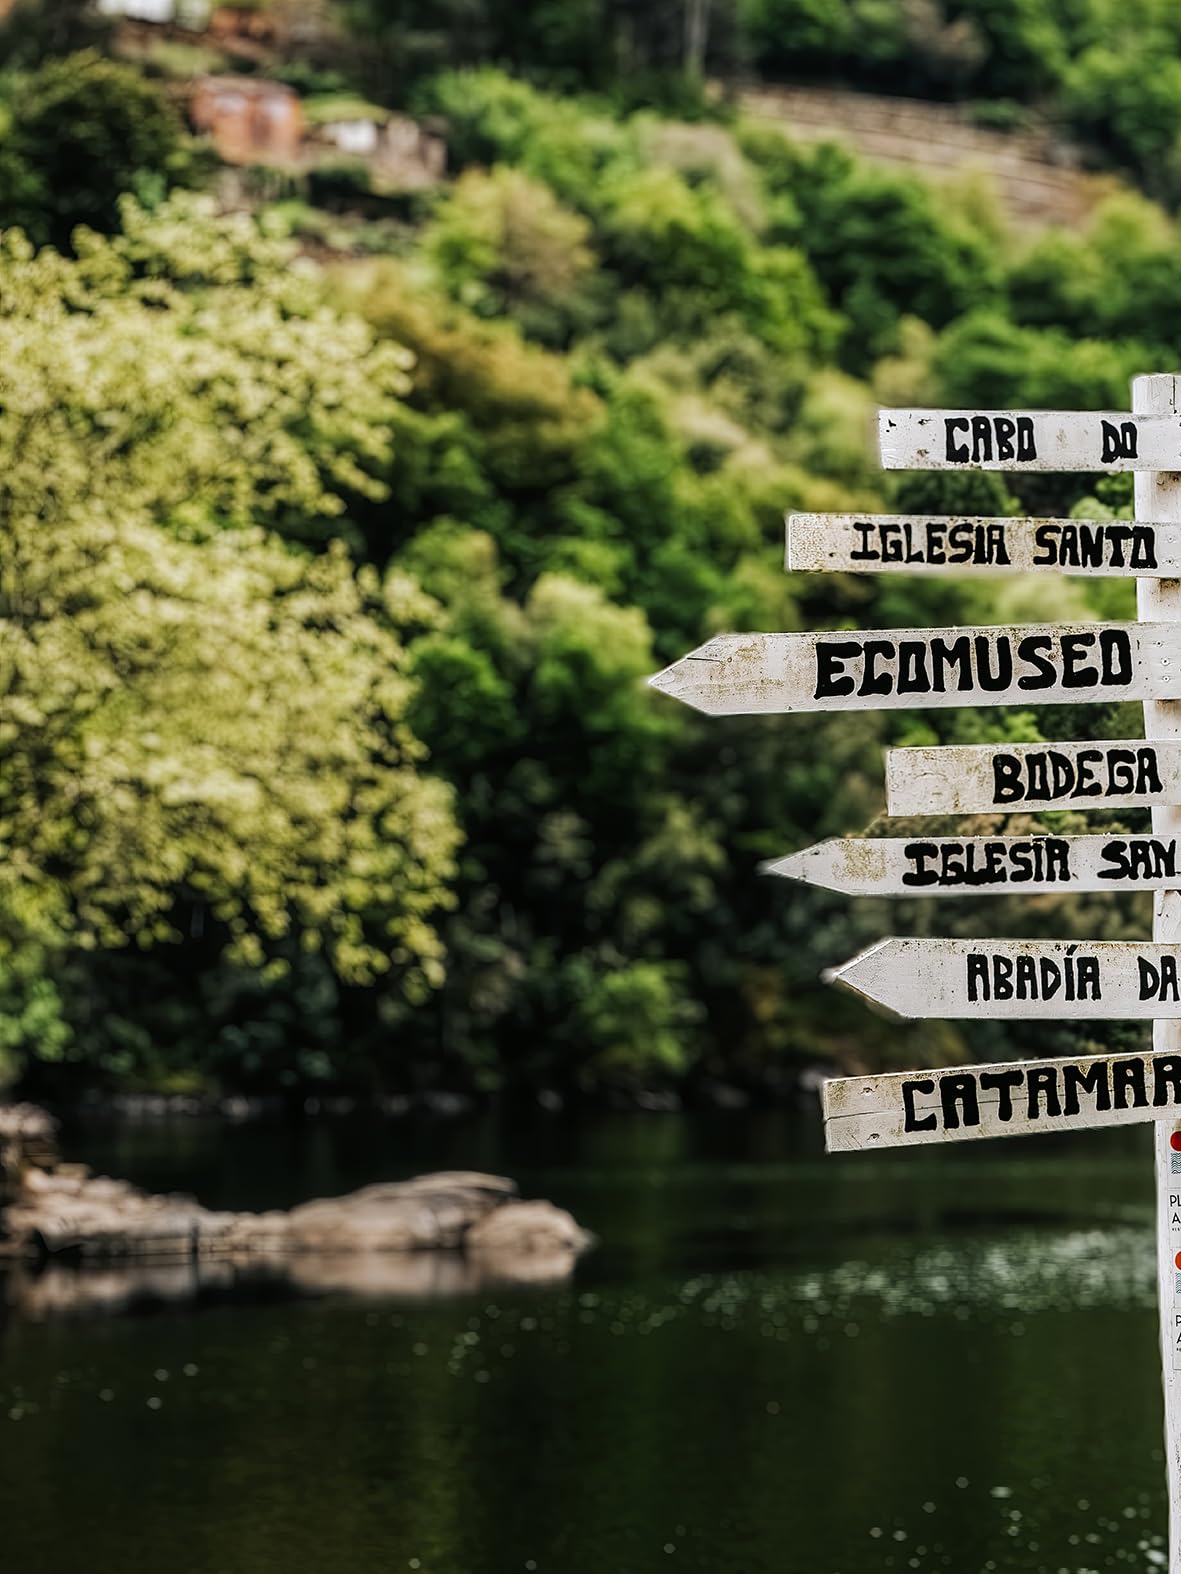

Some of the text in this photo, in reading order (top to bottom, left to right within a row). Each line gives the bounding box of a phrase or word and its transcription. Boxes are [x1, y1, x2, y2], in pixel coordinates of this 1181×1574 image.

[945, 417, 1036, 463] CABO
[1101, 420, 1138, 463] DO
[851, 522, 1009, 566] IGLESIA
[1033, 525, 1157, 569] SANTO
[815, 630, 1132, 699] ECOMUSEO
[993, 748, 1163, 804] BODEGA
[1097, 839, 1176, 880] SAN
[967, 945, 1101, 1001] ABADÍA
[1138, 955, 1180, 1001] DA
[1172, 1212, 1181, 1224] A
